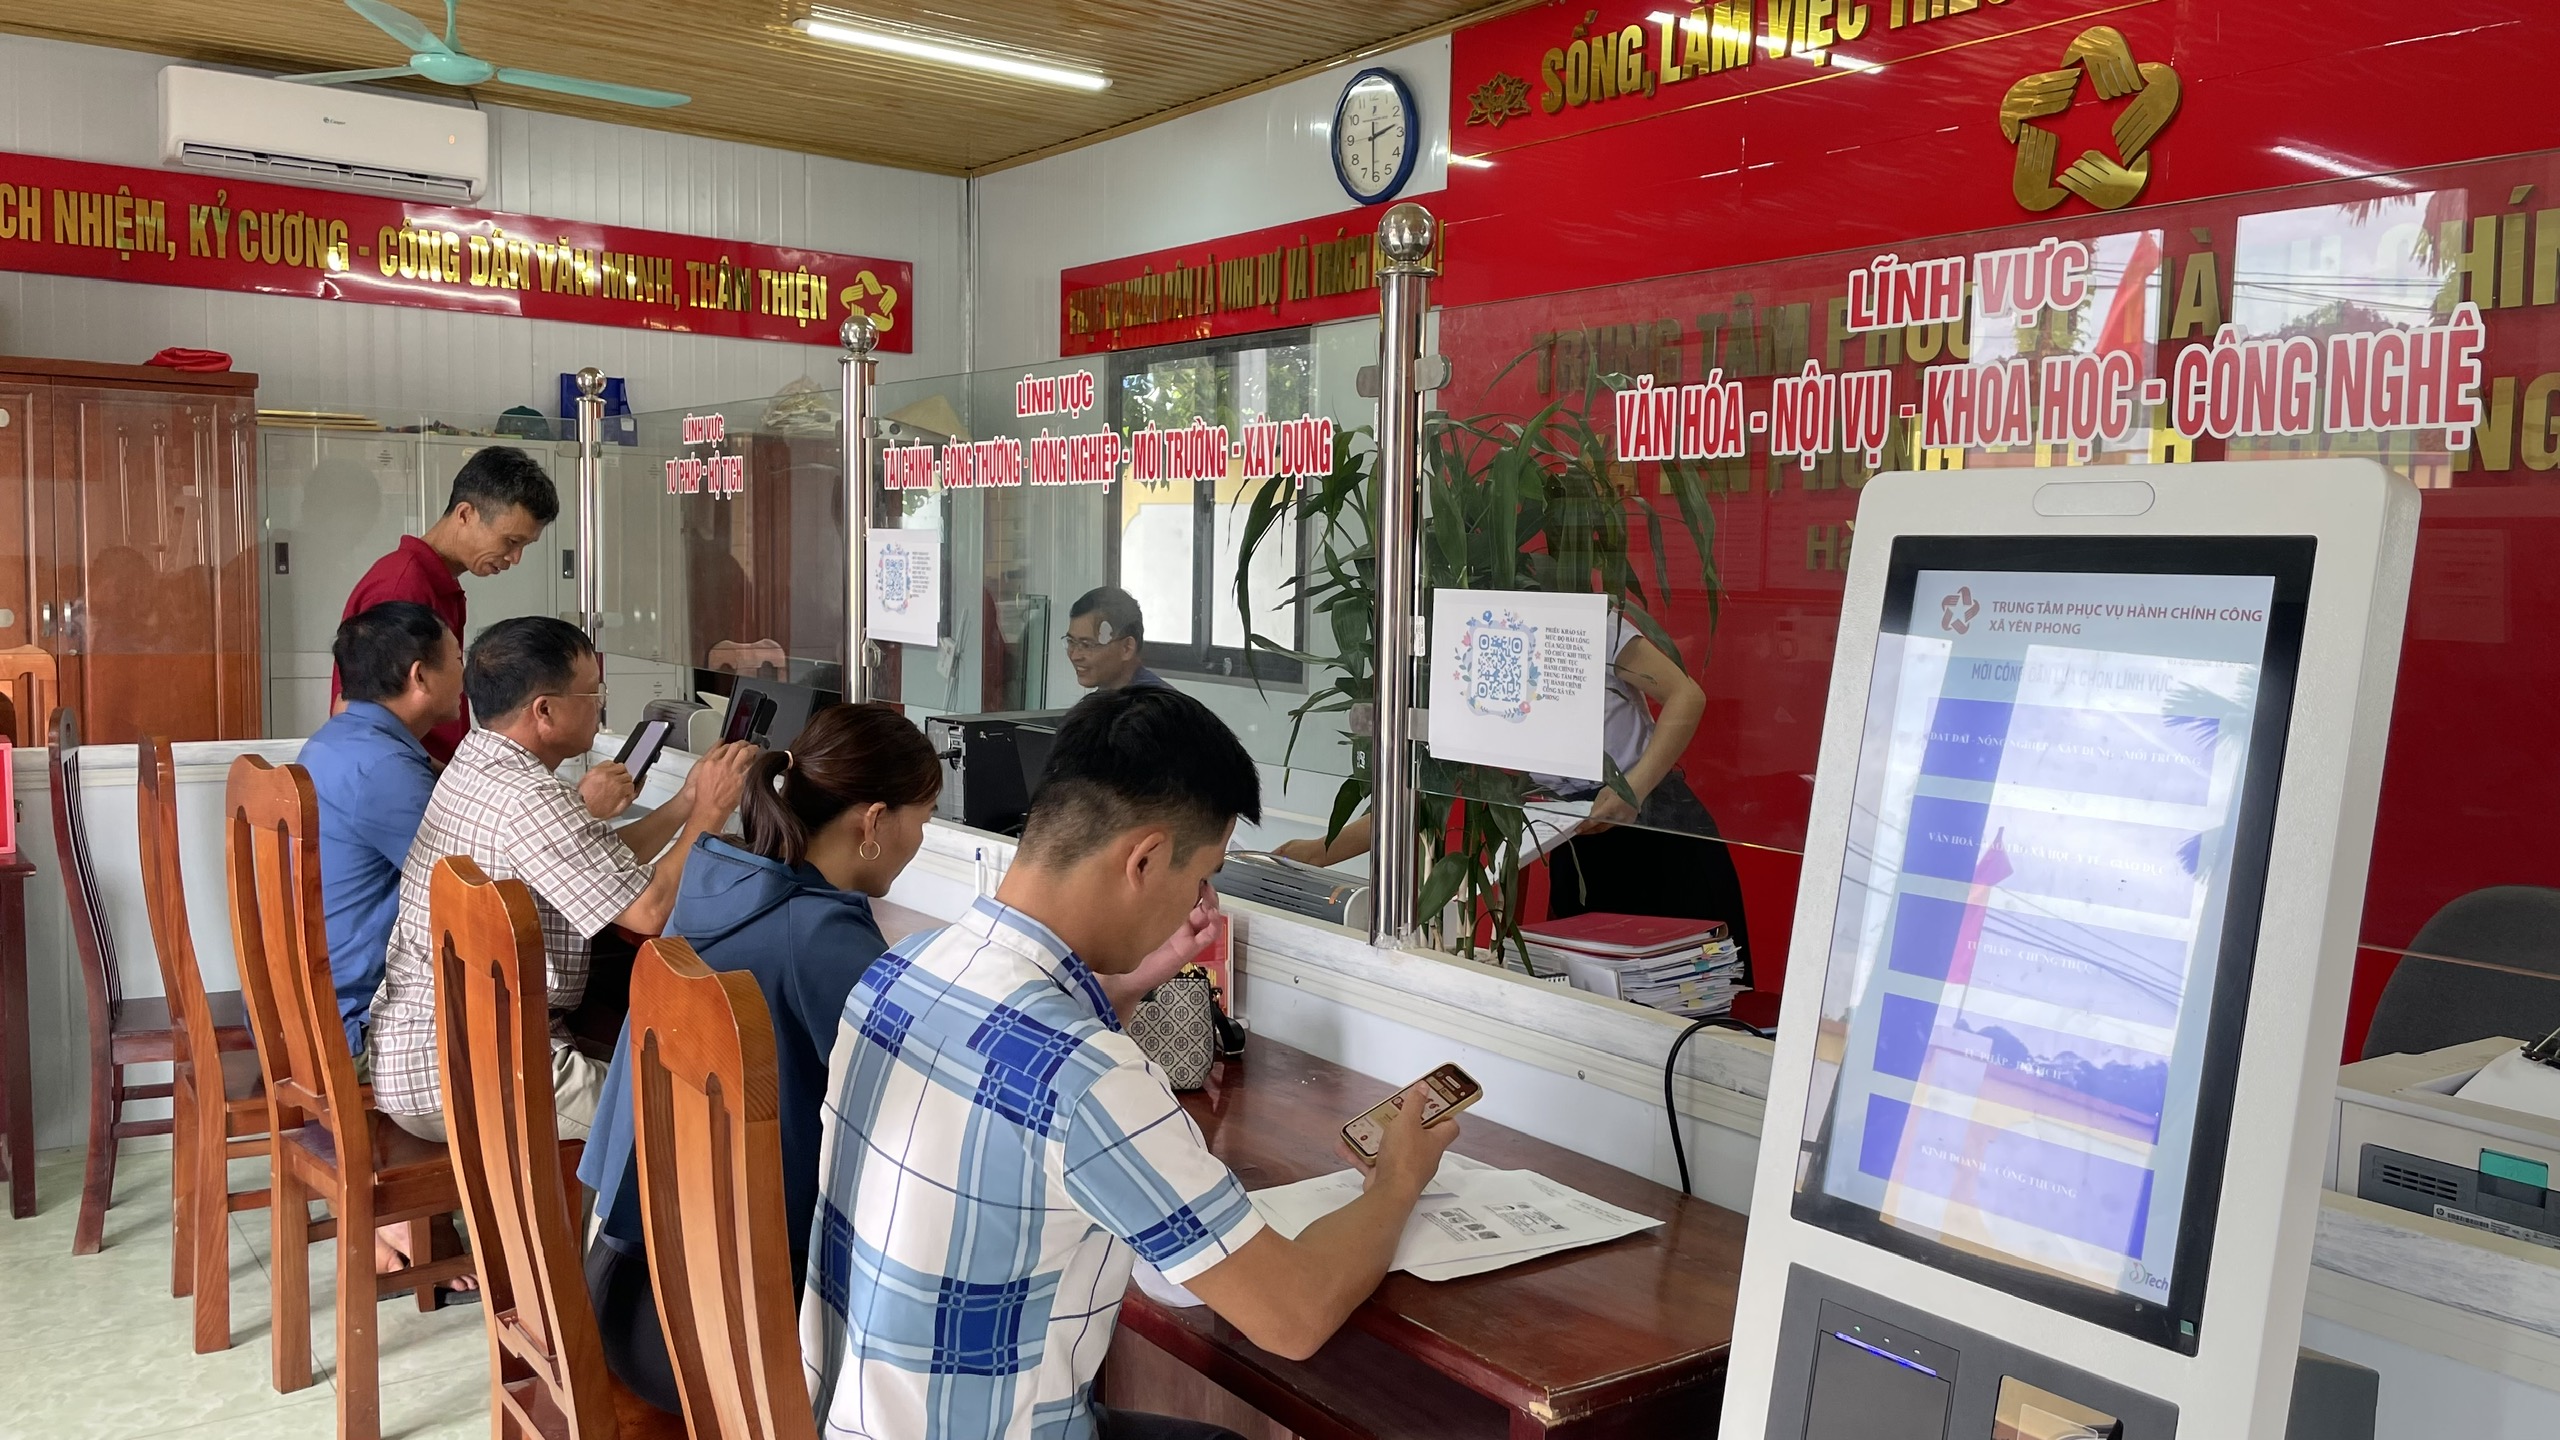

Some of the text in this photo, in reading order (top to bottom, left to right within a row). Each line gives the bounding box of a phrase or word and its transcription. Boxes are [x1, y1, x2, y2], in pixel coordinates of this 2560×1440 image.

[1541, 10, 1654, 115] SỐNG,
[1350, 114, 1360, 126] 10
[1392, 106, 1401, 118] 2
[1347, 135, 1355, 147] 9
[1396, 126, 1405, 138] 3
[1351, 153, 1360, 166] 8
[1392, 146, 1401, 158] 4
[1361, 167, 1369, 179] 7
[1373, 171, 1381, 183] 6
[1384, 163, 1393, 175] 5
[53, 185, 176, 261] NHIỆM,
[189, 189, 230, 259] KỶ
[238, 209, 349, 272] CƯƠNG
[379, 216, 460, 284] CÔNG
[469, 227, 530, 291] DÂN
[536, 236, 595, 298] VĂN
[601, 252, 681, 311] MINH,
[686, 255, 752, 313] THÂN
[758, 265, 828, 328] THIỆN
[1164, 259, 1197, 321] DÂN
[1219, 256, 1257, 312] VINH
[1258, 246, 1285, 315] DỰ
[1287, 235, 1310, 301] VÀ
[1313, 228, 1371, 297] TRÁCH
[1847, 254, 1966, 332] LĨNH
[1973, 237, 2090, 328] VỰC
[1696, 293, 1811, 379] TÂM
[1016, 369, 1095, 420] LĨNH VỰC
[1616, 374, 1677, 462] VĂN
[1679, 368, 1745, 460] HÓA
[1771, 359, 1836, 471] NỘI
[1841, 369, 1892, 469] VỤ
[1922, 359, 2032, 450] KHOA
[2041, 350, 2134, 462] HỌC
[2172, 324, 2318, 440] CÔNG
[2324, 301, 2485, 450] NGHỆ
[682, 413, 724, 448] LĨNH VỰC
[883, 411, 1334, 494] TÀI CHÍNH CÔNG THƯƠNG NÔNG NGHIỆP MÔI TRƯỜNG XÂY DỰNG
[678, 452, 702, 494] PHÁP
[707, 449, 722, 500] HỘ
[722, 455, 744, 500] TỊCH
[1992, 601, 2263, 623] TRUNG TÂM PHỤC VỤ HÀNH CHÍNH CÔNG
[1988, 618, 2081, 635] XÃ YÊN PHONG
[1971, 661, 1993, 680] MỜI
[1994, 662, 2024, 683] CÔNG
